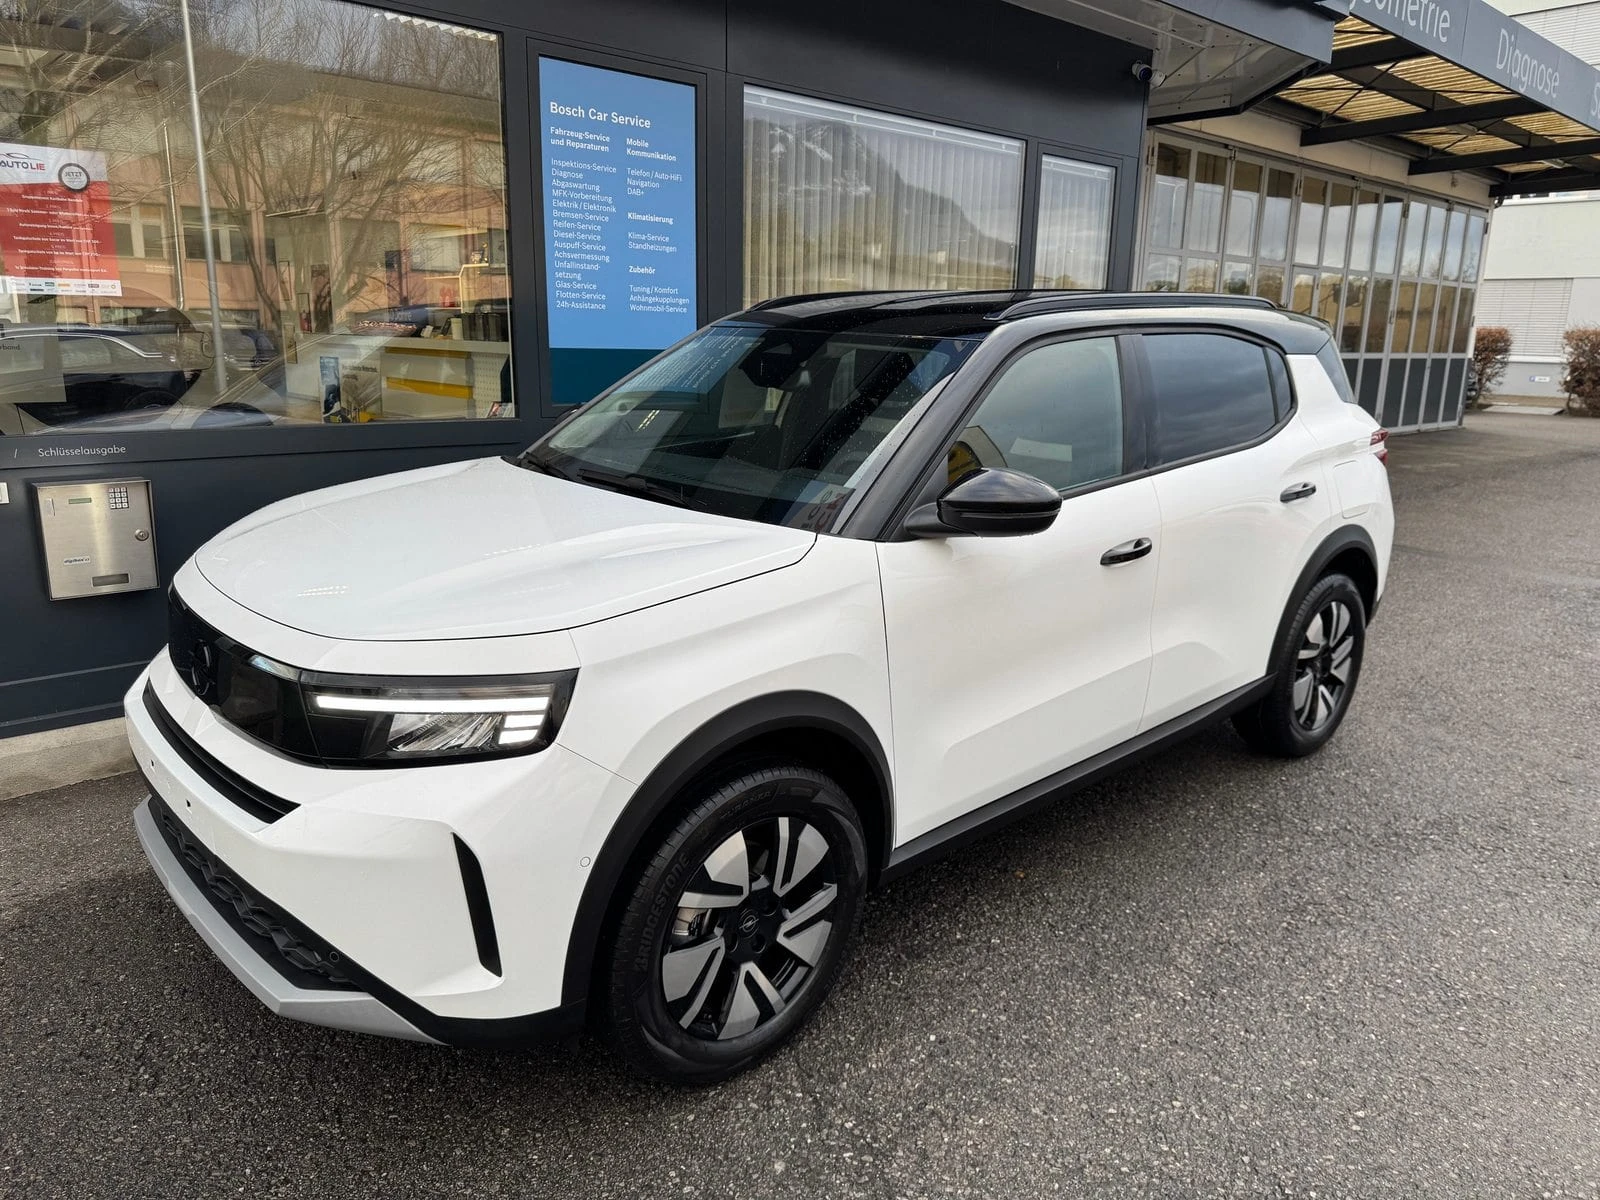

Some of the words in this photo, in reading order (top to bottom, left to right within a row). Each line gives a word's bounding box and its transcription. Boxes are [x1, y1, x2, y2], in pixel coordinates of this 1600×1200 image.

[1496, 28, 1560, 98] Diagnose
[550, 101, 585, 118] Bosch
[588, 108, 608, 121] Car
[611, 111, 651, 128] Service
[550, 126, 610, 142] Fahrzeug-Service
[550, 138, 564, 146] und
[566, 139, 610, 152] Reparaturen
[626, 137, 649, 148] Mobile
[626, 147, 677, 161] Kommunikation
[551, 157, 617, 173] Inspektions-Service
[551, 167, 584, 179] Diagnose
[627, 167, 650, 178] Telefon
[654, 171, 682, 182] Auto-HiFi
[551, 178, 600, 193] Abgaswartung
[626, 177, 660, 189] Navigation
[552, 188, 613, 204] MFK-Vorbereitung
[627, 187, 644, 196] DAB+
[552, 198, 579, 209] Elektrik
[583, 202, 617, 213] Elektronik
[552, 209, 610, 222] Bremsen-Service
[627, 211, 674, 225] Klimatisierung
[553, 219, 601, 232] Reifen-Service
[553, 229, 601, 242] Diesel-Service
[628, 231, 670, 242] Klima-Service
[554, 240, 606, 252] Auspuff-Service
[628, 240, 677, 253] Standheizungen
[554, 250, 610, 263] Achsvermessung
[554, 260, 601, 271] Unfallinstand-
[628, 265, 656, 275] Zubehör
[554, 271, 582, 281] setzung
[555, 280, 597, 290] Glas-Service
[629, 284, 650, 295] Tuning
[654, 286, 679, 295] Komfort
[555, 290, 606, 301] Flotten-Service
[629, 294, 690, 306] Anhängekupplungen
[556, 300, 606, 310] 24h-Assistance
[629, 303, 688, 313] Wohnmobil-Service
[38, 444, 127, 458] Schlüsselausgabe
